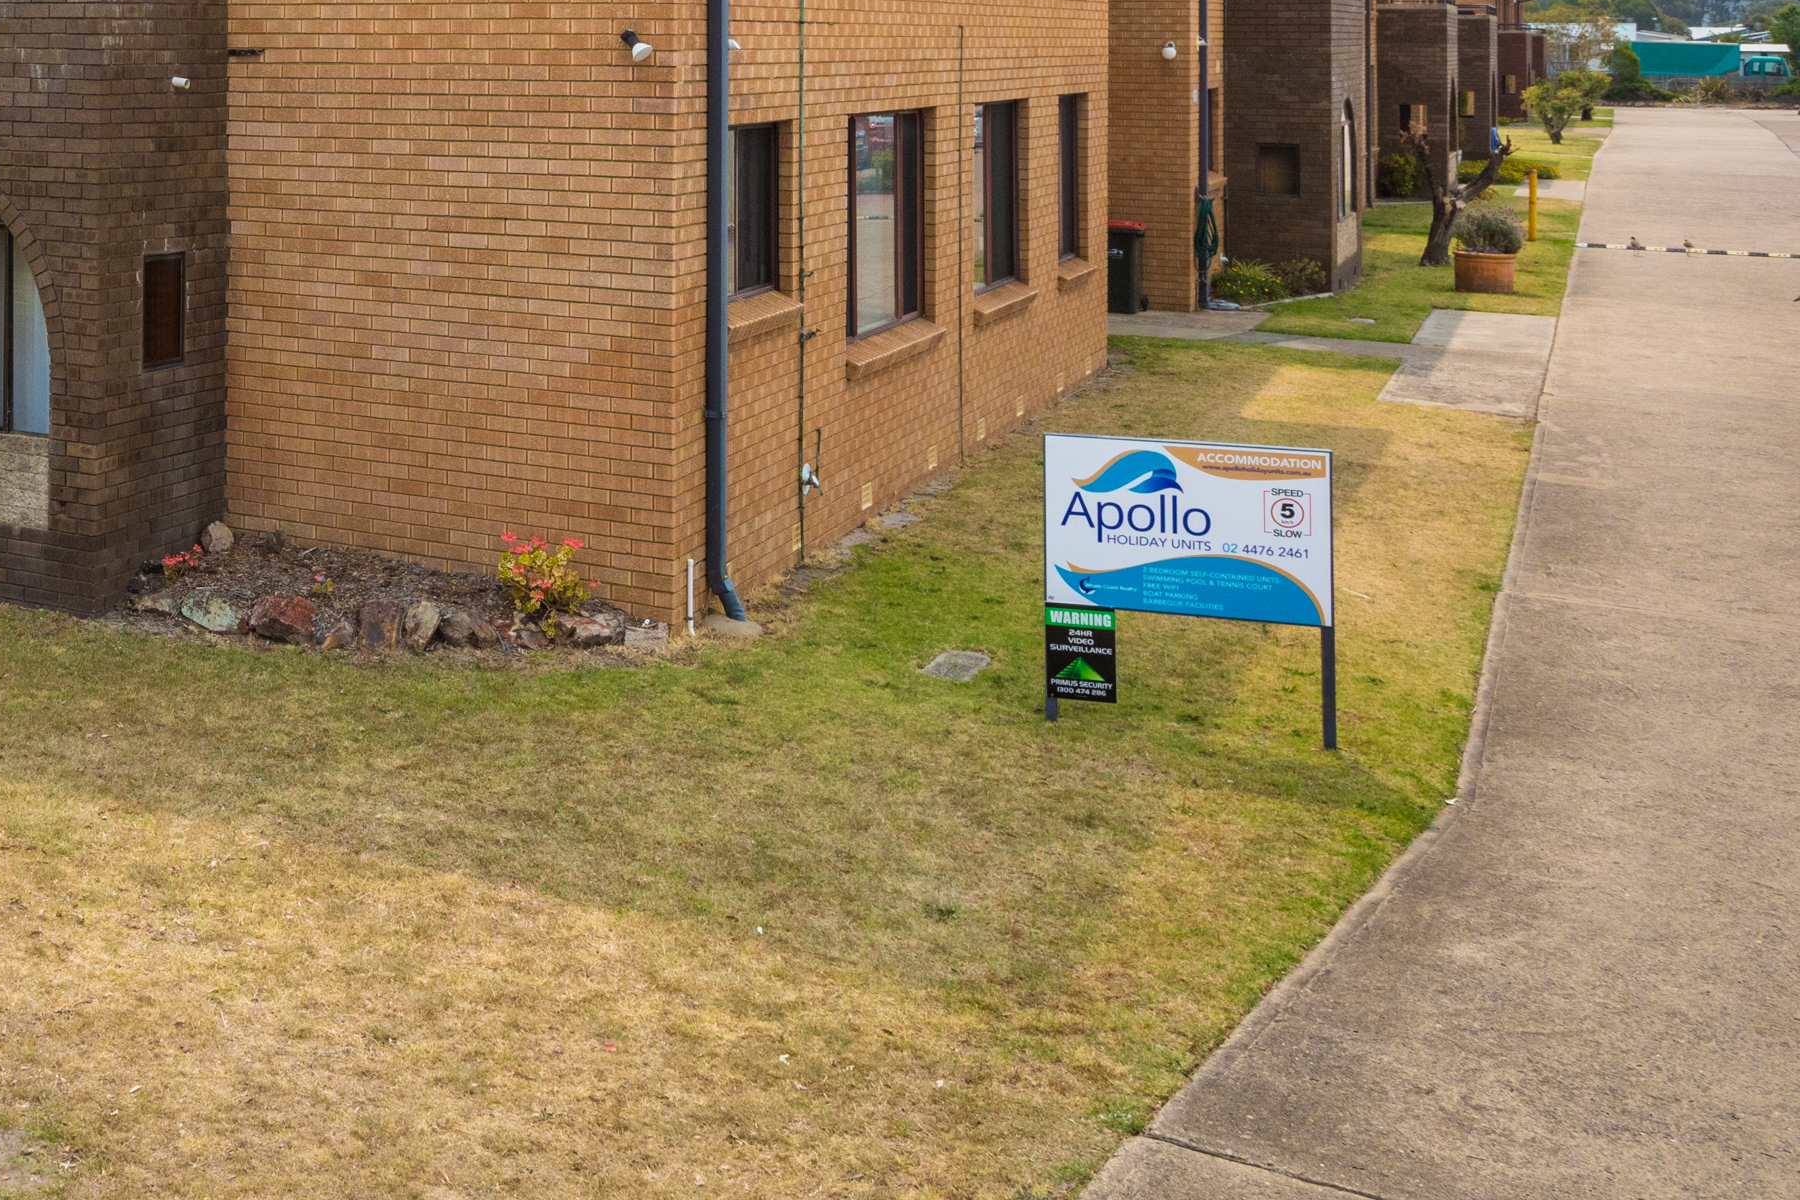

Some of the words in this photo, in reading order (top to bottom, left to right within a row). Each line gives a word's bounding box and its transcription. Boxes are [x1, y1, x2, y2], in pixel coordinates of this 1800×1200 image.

[1197, 453, 1322, 470] ACCOMMODATION
[1202, 465, 1311, 477] www.apolloholidayunits.com.au
[1271, 488, 1304, 497] SPEED
[1061, 491, 1212, 543] Apollo
[1280, 503, 1295, 519] 5
[1273, 529, 1302, 538] SLOW
[1107, 534, 1167, 549] HOLIDAY
[1171, 539, 1212, 551] UNITS
[1222, 543, 1238, 553] 02
[1242, 544, 1274, 556] 4476
[1278, 547, 1309, 559] 2461
[1149, 567, 1188, 576] BEDROOM
[1190, 570, 1255, 581] SELF-CONTAINED
[1257, 576, 1279, 584] UNITS
[1142, 574, 1184, 584] SWIMMING
[1185, 578, 1207, 586] POOL
[1217, 580, 1244, 589] TENNIS
[1246, 583, 1273, 591] COURT
[1162, 583, 1179, 591] WIFI
[1165, 591, 1198, 600] PARKING
[1142, 597, 1184, 607] BARBEQUE
[1185, 601, 1224, 611] FACILITIES
[1050, 610, 1112, 628] WARNING
[1069, 629, 1093, 637] 24HR
[1067, 637, 1094, 645] VIDEO
[1050, 643, 1113, 655] SURVEILLANCE
[1051, 678, 1078, 687] PRIMUS
[1079, 680, 1113, 690] SECURITY
[1057, 686, 1074, 694] 1300
